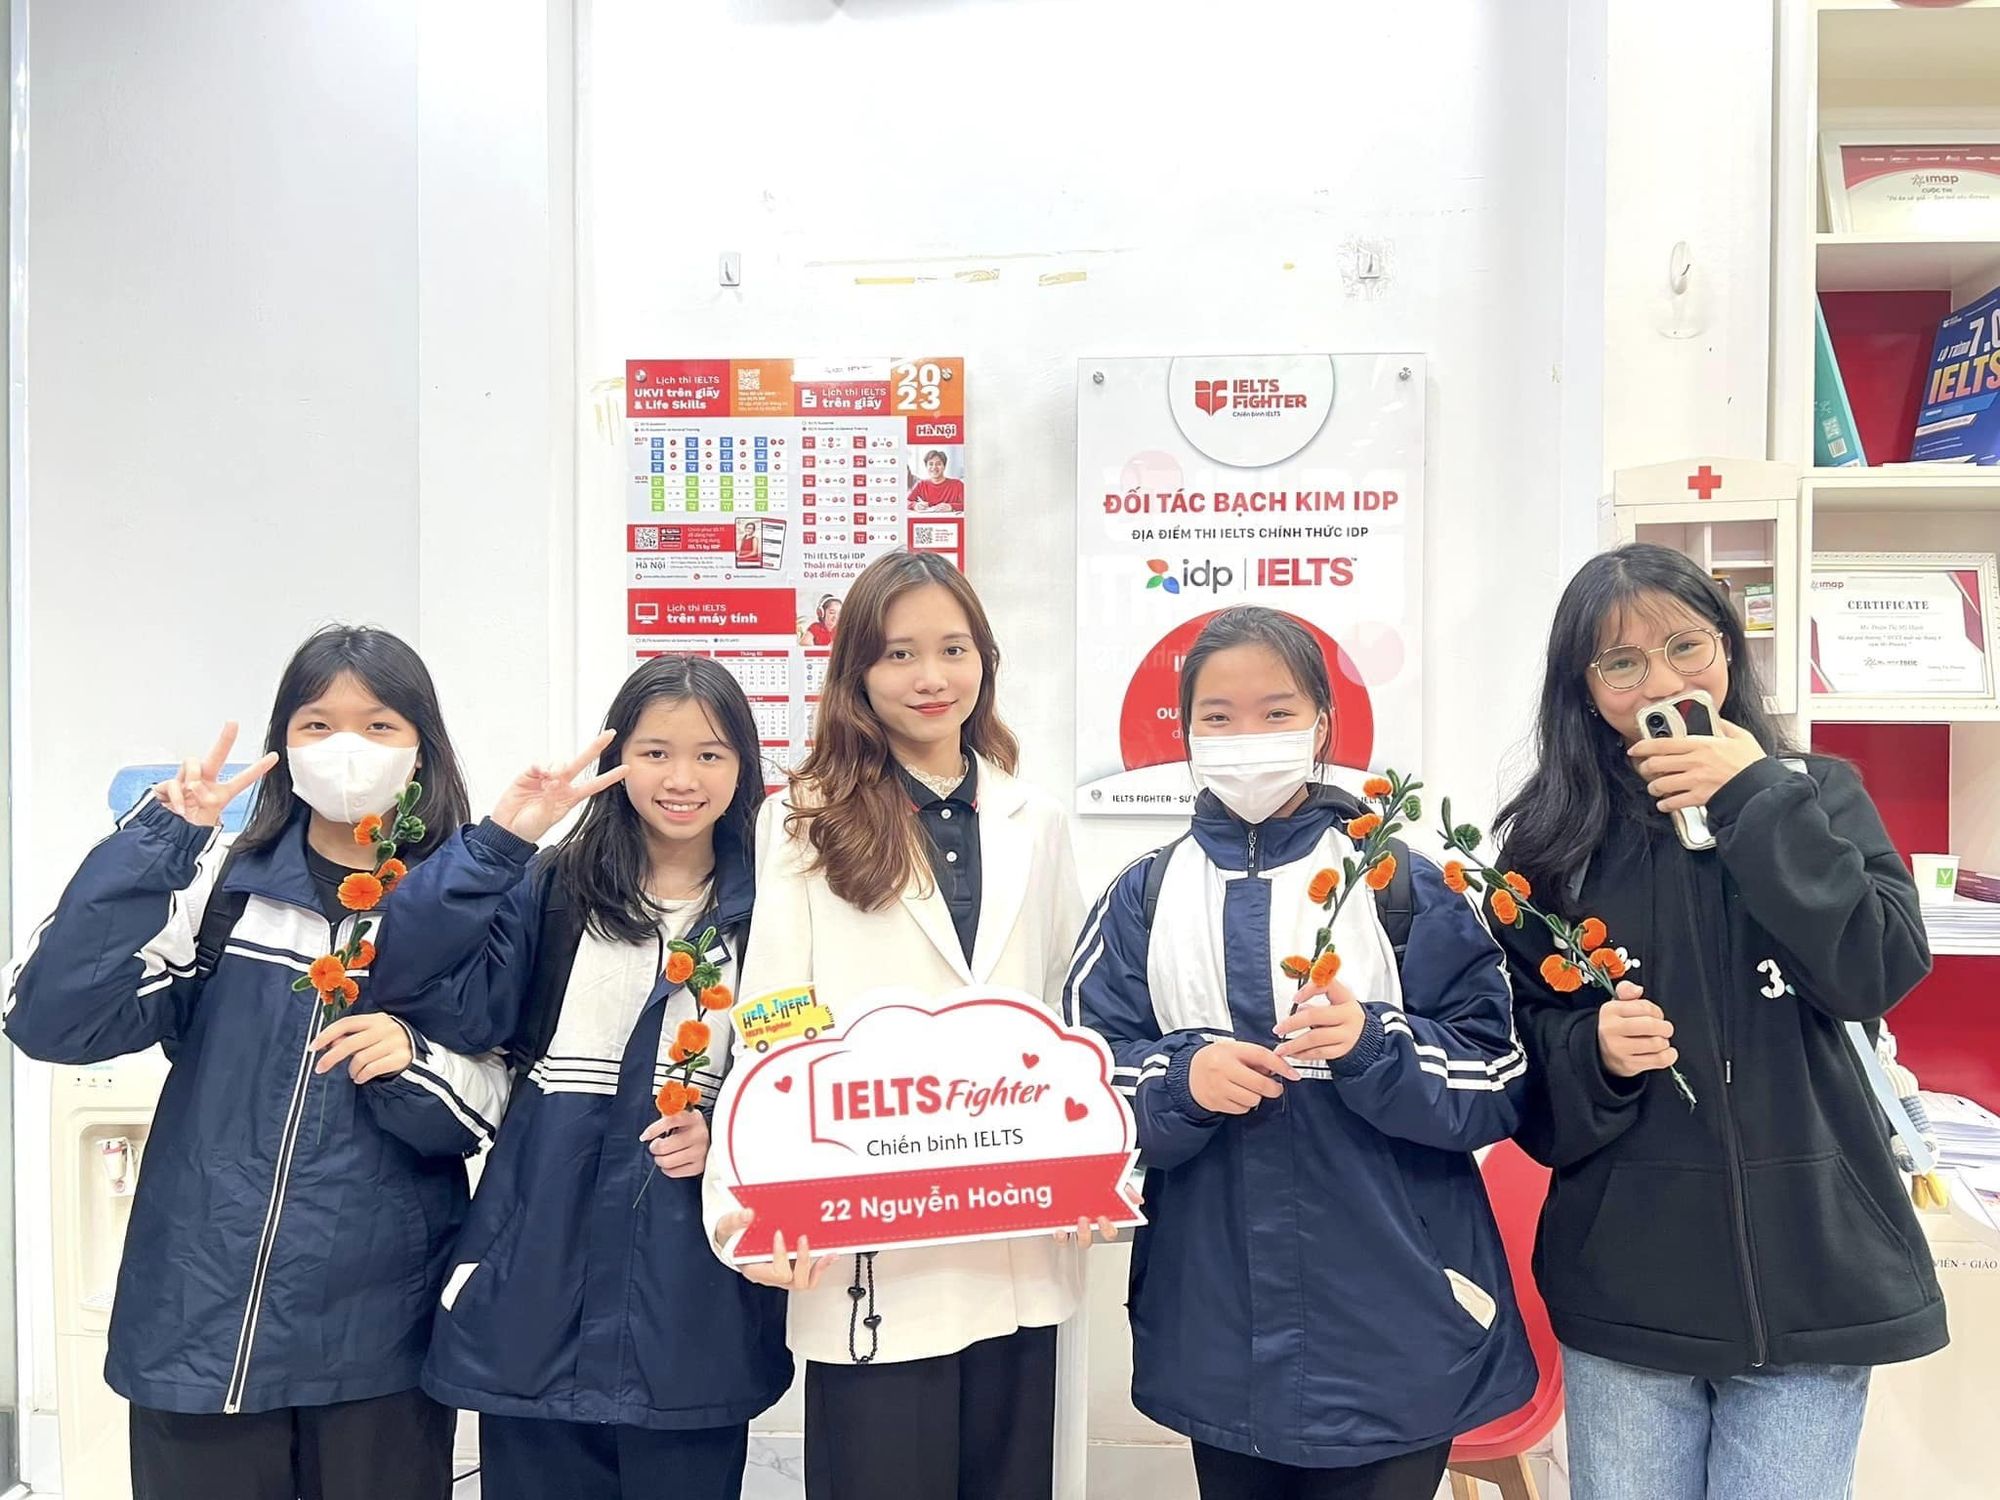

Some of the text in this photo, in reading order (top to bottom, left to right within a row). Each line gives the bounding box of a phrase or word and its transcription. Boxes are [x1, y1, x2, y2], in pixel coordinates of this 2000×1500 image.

[656, 376, 720, 385] Lịch thi IELTS
[1928, 349, 2000, 405] IELTS
[634, 389, 663, 397] UKVI
[667, 388, 692, 397] trên
[822, 388, 887, 397] Lịch thi IELTS
[1233, 379, 1280, 393] IELTS
[646, 400, 669, 409] Life
[672, 400, 707, 409] Skills
[822, 398, 851, 408] trên
[1233, 394, 1307, 409] FIGHTER
[918, 424, 956, 438] Hà Nội
[1103, 486, 1399, 517] ĐỐI TÁC BẠCH KIM IDP
[1131, 525, 1369, 542] ĐỊA ĐIỂM THI IELTS CHÍNH THỨC IDP
[636, 561, 648, 569] Hà
[650, 561, 666, 570] Nội
[1183, 557, 1354, 594] idp IELTS
[667, 604, 727, 613] Lịch thi IELTS
[1847, 600, 1930, 610] CERTIFICATE
[667, 613, 758, 626] trên máy tính
[1113, 795, 1135, 803] IELTS
[1137, 795, 1172, 803] FIGHTER
[832, 1075, 1051, 1121] IELTS Fighter
[866, 1129, 1024, 1156] Chiến binh IELTS
[820, 1182, 1053, 1223] 22 Nguyễn Hoàng
[1970, 1256, 1998, 1269] GIÁO
